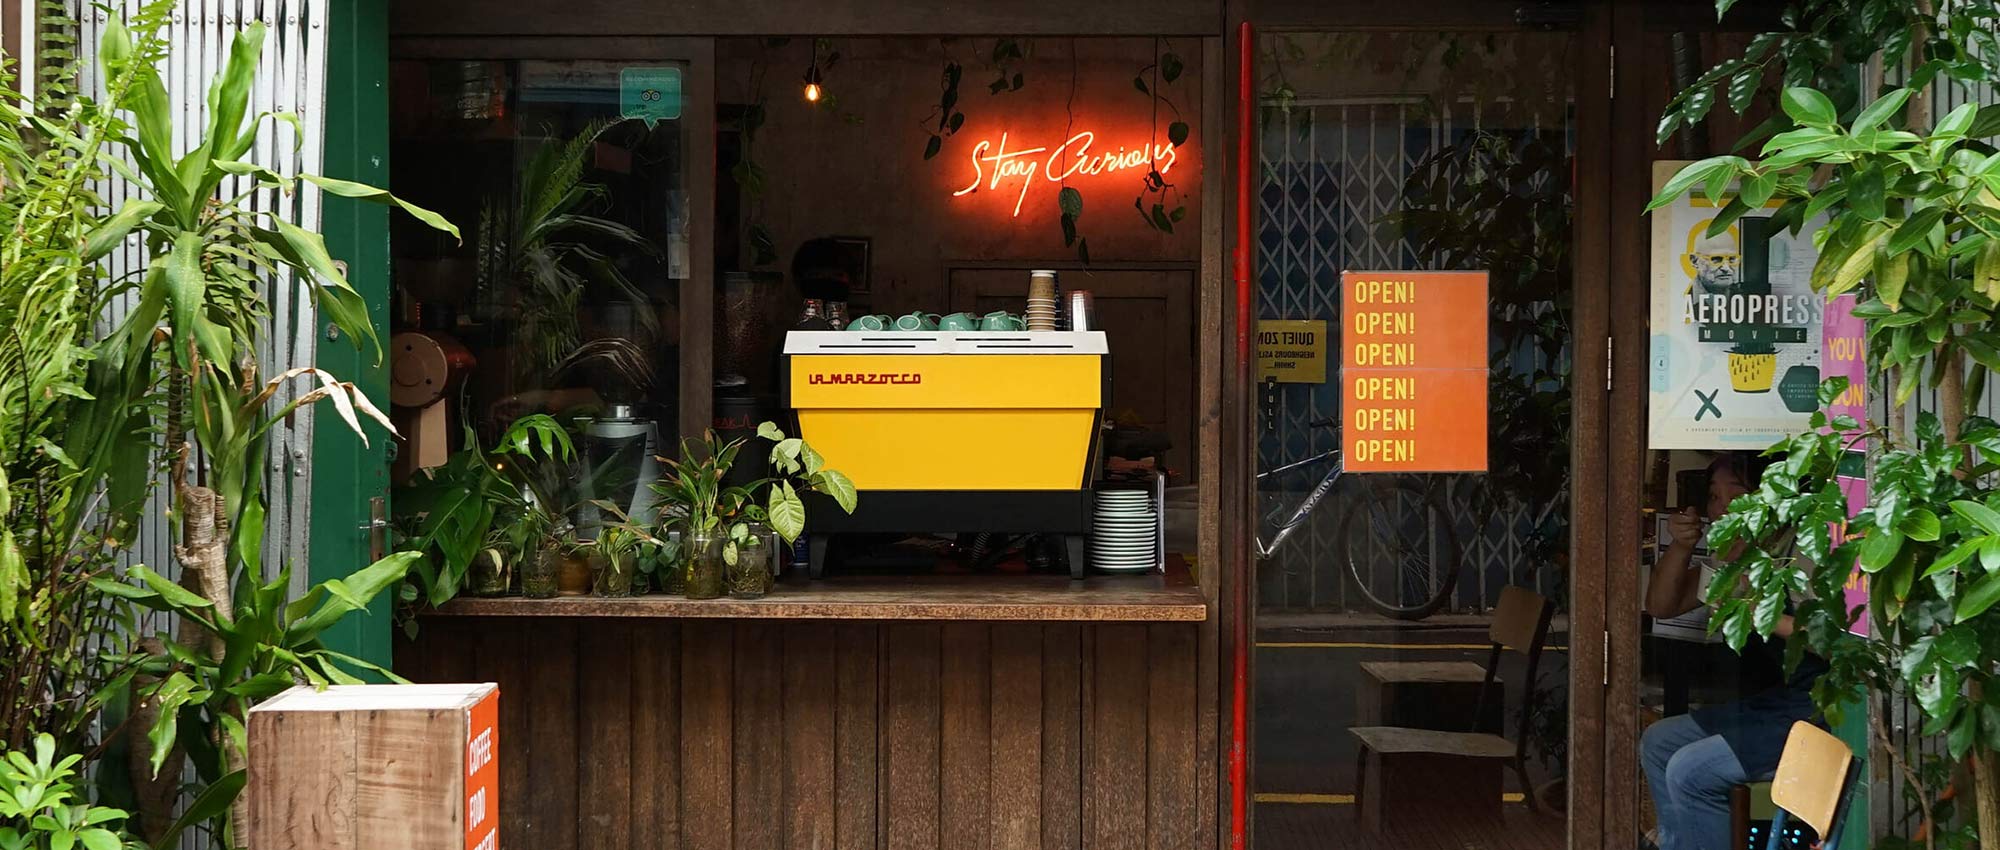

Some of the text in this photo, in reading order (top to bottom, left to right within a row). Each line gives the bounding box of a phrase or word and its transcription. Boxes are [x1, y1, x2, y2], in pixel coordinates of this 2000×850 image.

[952, 131, 1177, 217] Stay Curious
[1355, 281, 1415, 304] OPEN!
[1682, 293, 1824, 325] AEROPRESS
[1355, 312, 1415, 335] OPEN!
[1704, 329, 1801, 339] MOVIE
[1355, 343, 1415, 366] OPEN!
[1827, 337, 1856, 361] YOU
[1355, 377, 1415, 400] OPEN!
[1831, 383, 1864, 407] ON
[1355, 408, 1415, 431] OPEN!
[1355, 439, 1415, 462] OPEN!
[469, 726, 492, 777] COFFEE
[469, 785, 486, 832] FOOD
